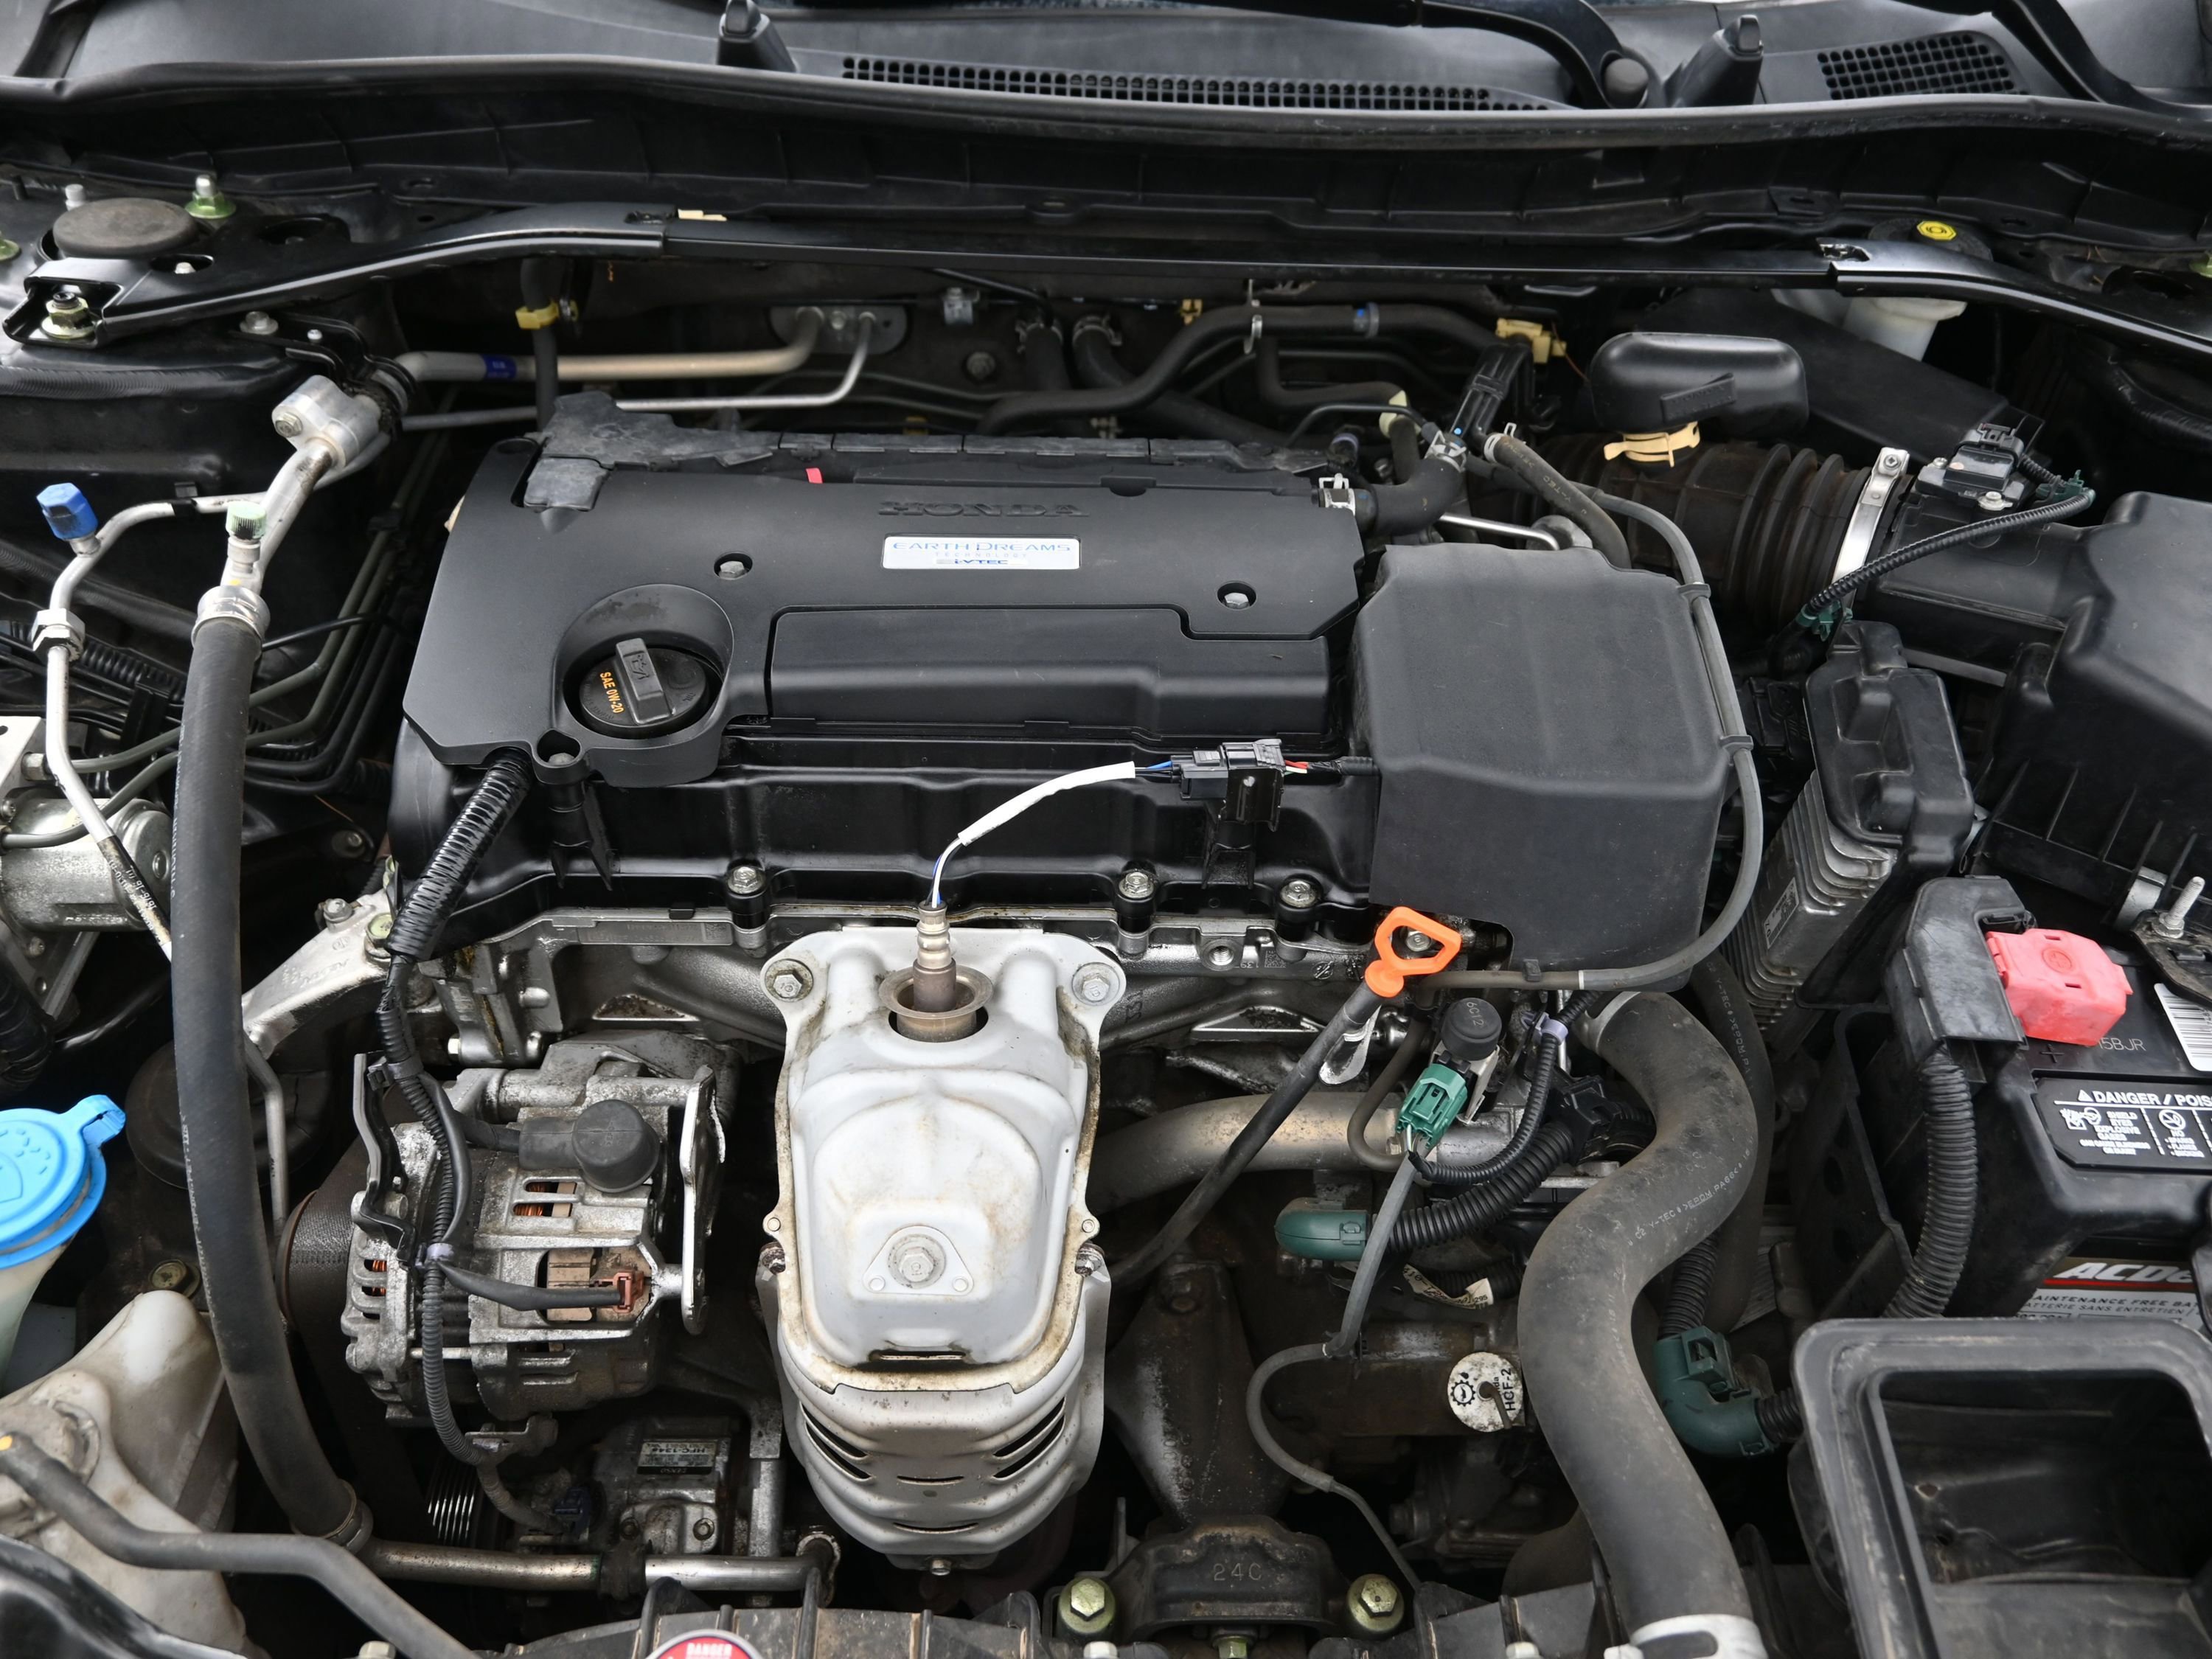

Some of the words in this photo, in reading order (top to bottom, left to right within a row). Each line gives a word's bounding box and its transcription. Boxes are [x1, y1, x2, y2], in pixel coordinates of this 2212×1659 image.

[878, 501, 1090, 516] HONDA
[893, 542, 970, 551] EARTH
[976, 542, 1071, 552] DREAMS
[600, 672, 616, 689] SAE
[1466, 1001, 1484, 1026] 6C12
[2092, 1091, 2161, 1105] DANGER
[2174, 1094, 2212, 1107] POIS
[1649, 1210, 1676, 1228] Y-TEC
[2053, 1262, 2193, 1283] ACDe
[2031, 1295, 2126, 1304] AINTENANCE
[1213, 1562, 1262, 1582] 24C
[686, 1642, 732, 1656] DANGER
